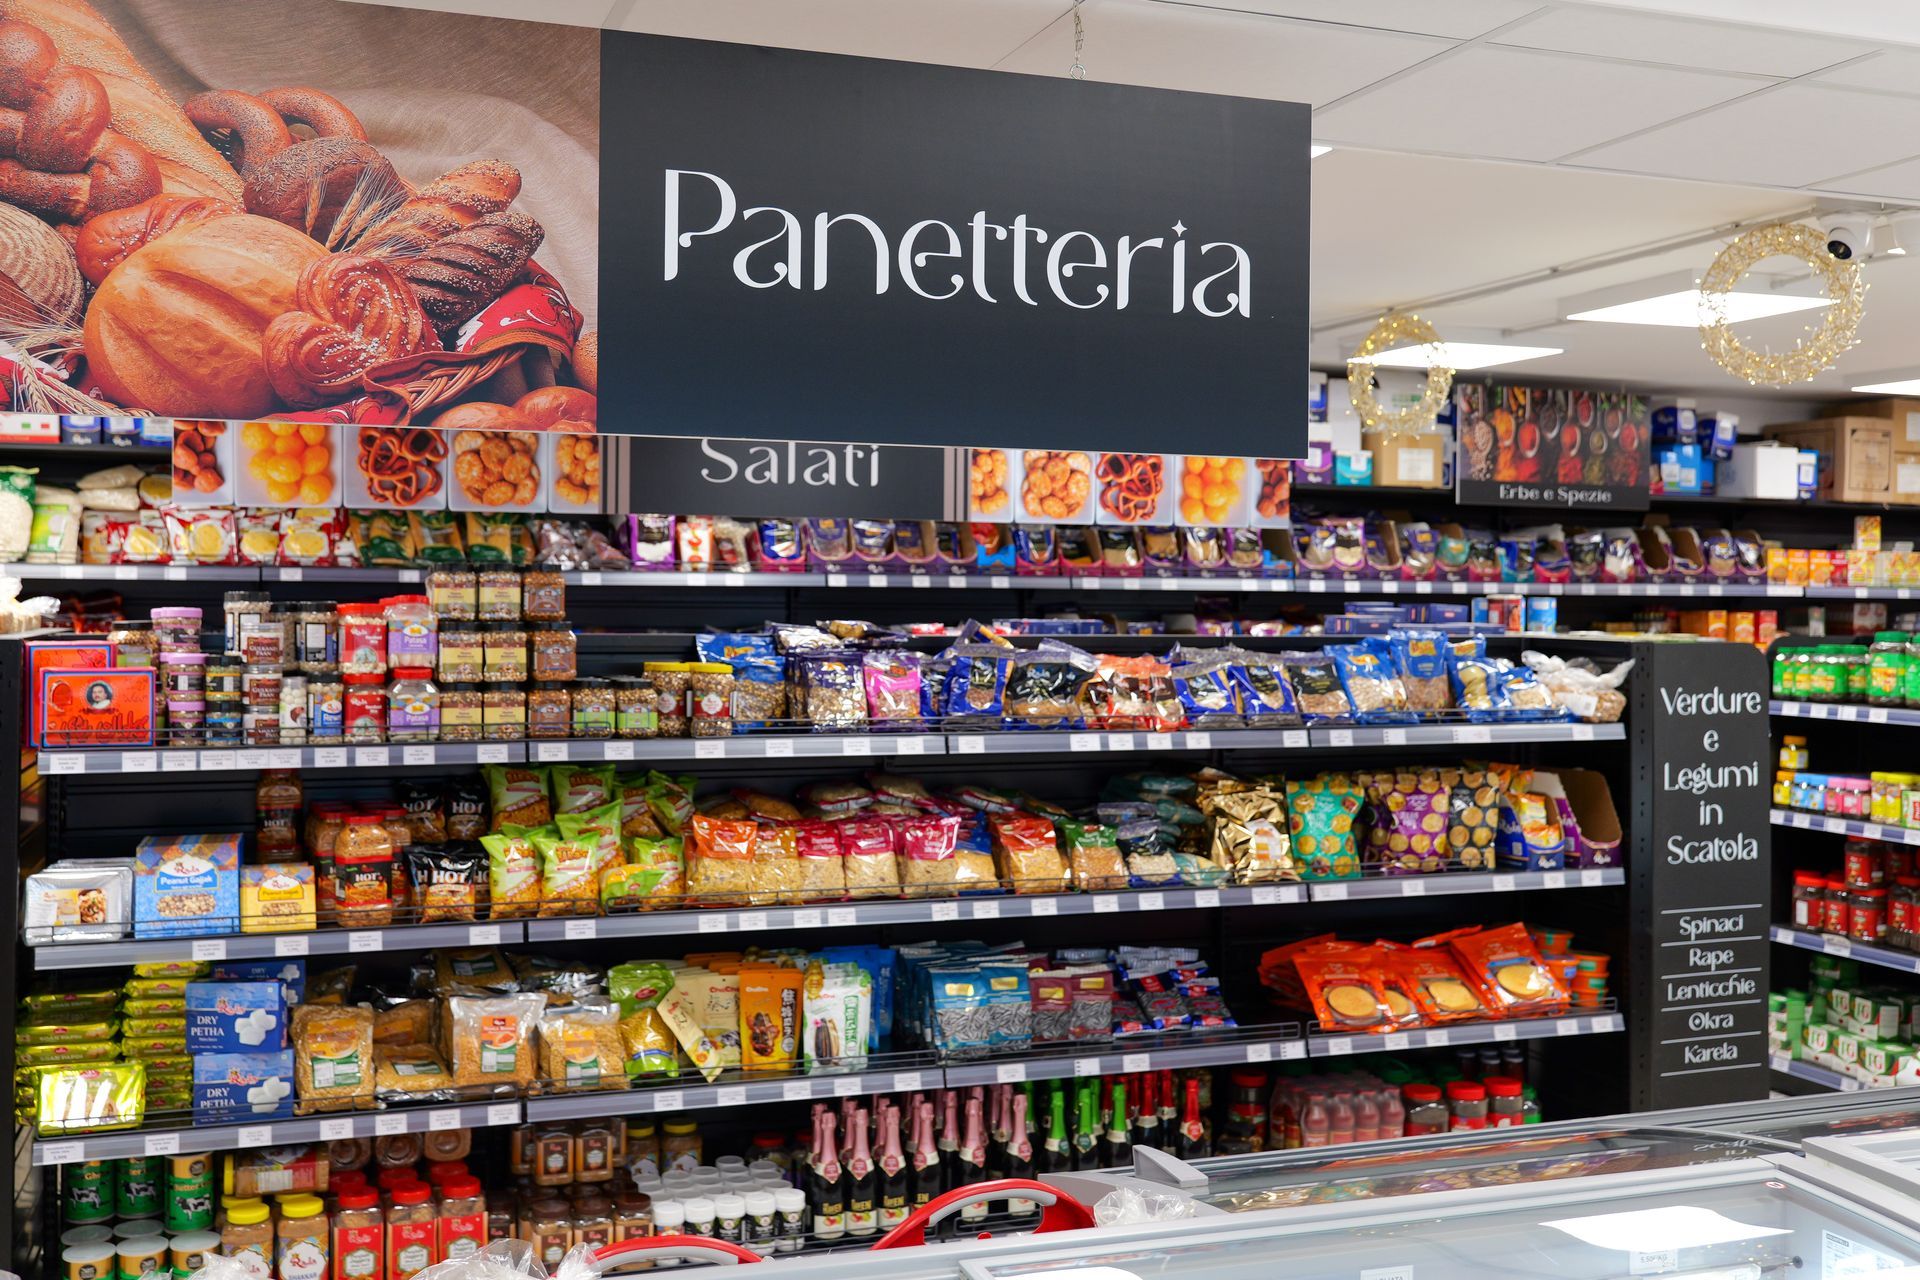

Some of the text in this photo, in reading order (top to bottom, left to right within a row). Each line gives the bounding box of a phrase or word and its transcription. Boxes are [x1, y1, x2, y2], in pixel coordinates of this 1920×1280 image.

[663, 169, 1251, 318] Panetteria
[700, 438, 879, 488] Salati
[1499, 484, 1613, 507] Erbe e Spezie
[1660, 686, 1762, 716] Verdure
[1703, 729, 1720, 752] e
[1663, 760, 1759, 795] Legumi
[1699, 800, 1724, 826] in
[1667, 832, 1759, 865] Scatola
[355, 872, 377, 882] HOT
[432, 868, 471, 884] HOT
[1679, 914, 1744, 941] Spinaci
[1689, 947, 1735, 972] Rape
[1667, 973, 1757, 1002] Lenticchie
[191, 1027, 225, 1037] PETHA
[197, 1016, 219, 1025] DRY
[1688, 1010, 1735, 1032] Okra
[1684, 1042, 1739, 1064] Karela
[200, 1098, 236, 1109] PETHA
[207, 1087, 230, 1098] DRY
